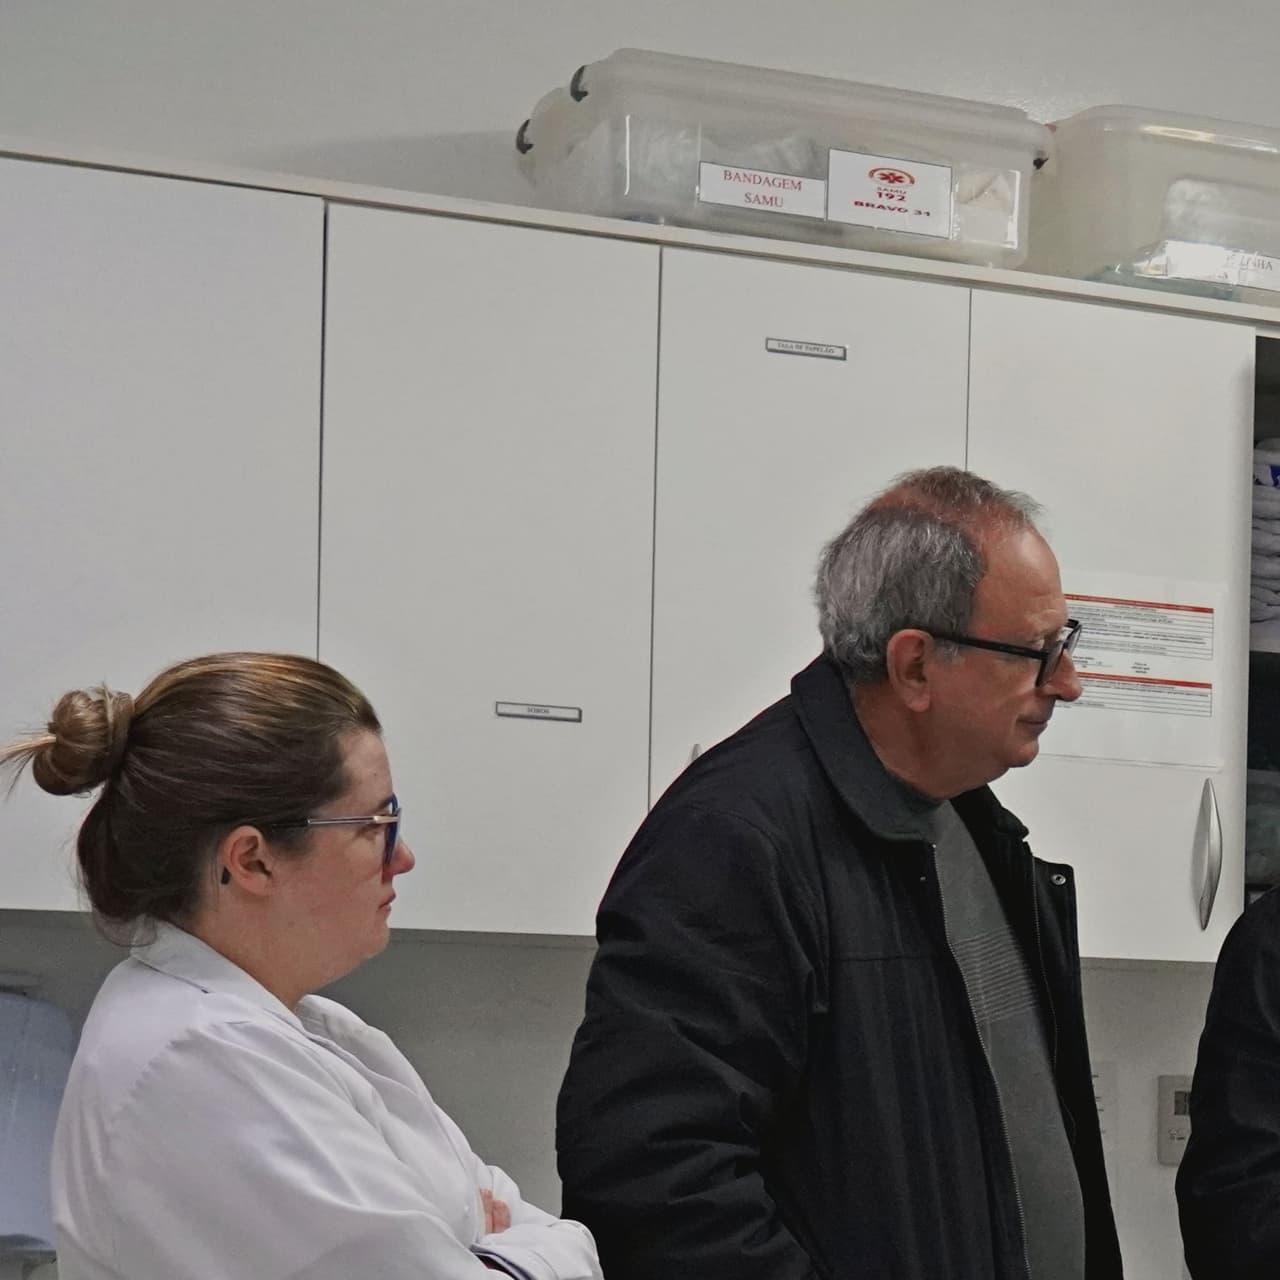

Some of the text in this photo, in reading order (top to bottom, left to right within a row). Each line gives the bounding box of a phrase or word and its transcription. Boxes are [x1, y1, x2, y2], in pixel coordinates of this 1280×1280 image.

[723, 169, 802, 191] BANDAGEM
[744, 192, 784, 208] SAMU
[877, 191, 906, 202] 192
[853, 200, 908, 214] BRAVO
